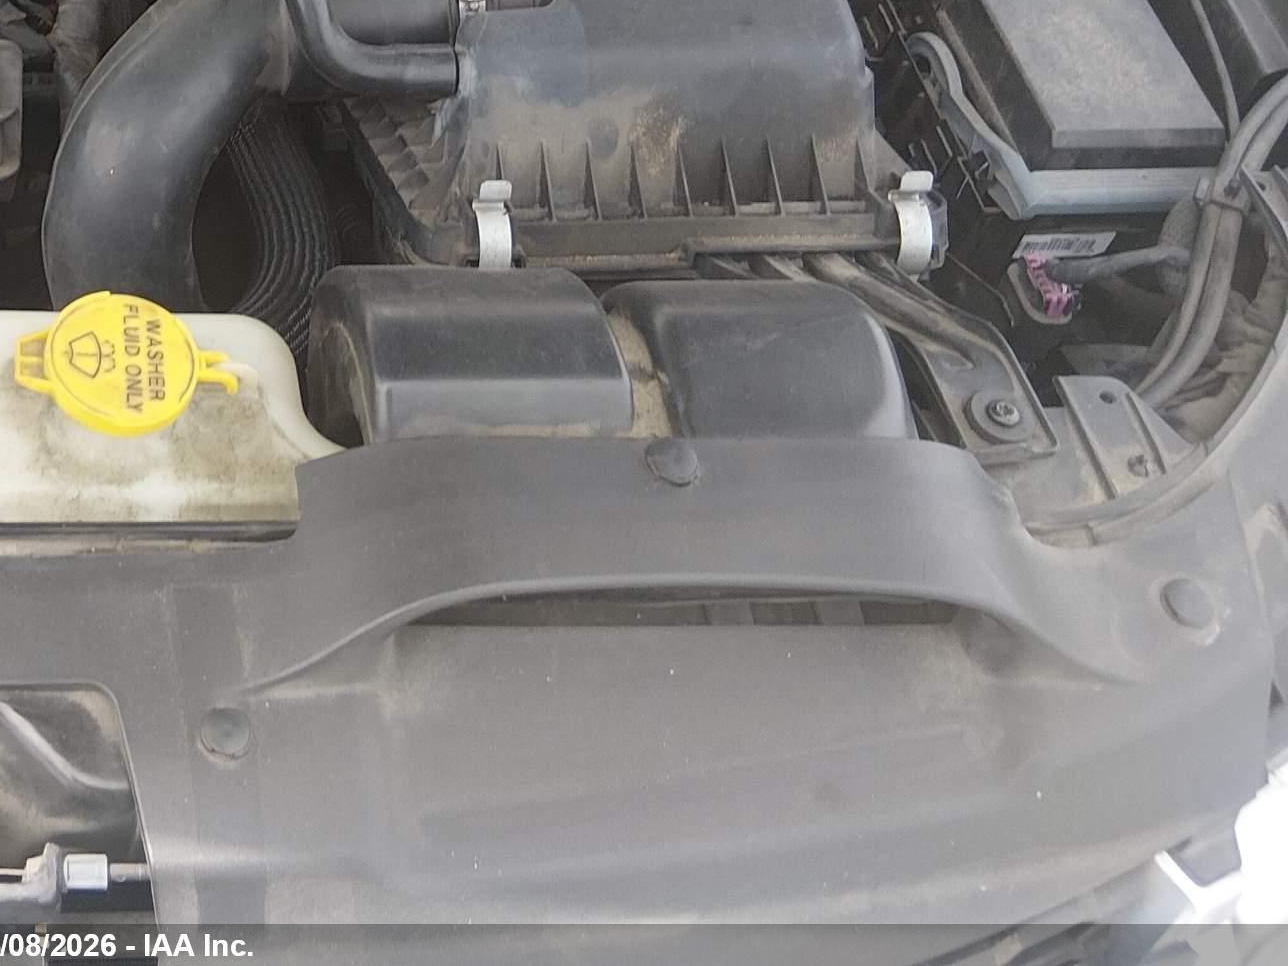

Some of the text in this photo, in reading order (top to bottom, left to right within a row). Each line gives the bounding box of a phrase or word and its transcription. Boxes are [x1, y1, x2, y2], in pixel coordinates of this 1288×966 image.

[123, 303, 144, 413] FLUID ONLY
[146, 319, 166, 402] WASHER
